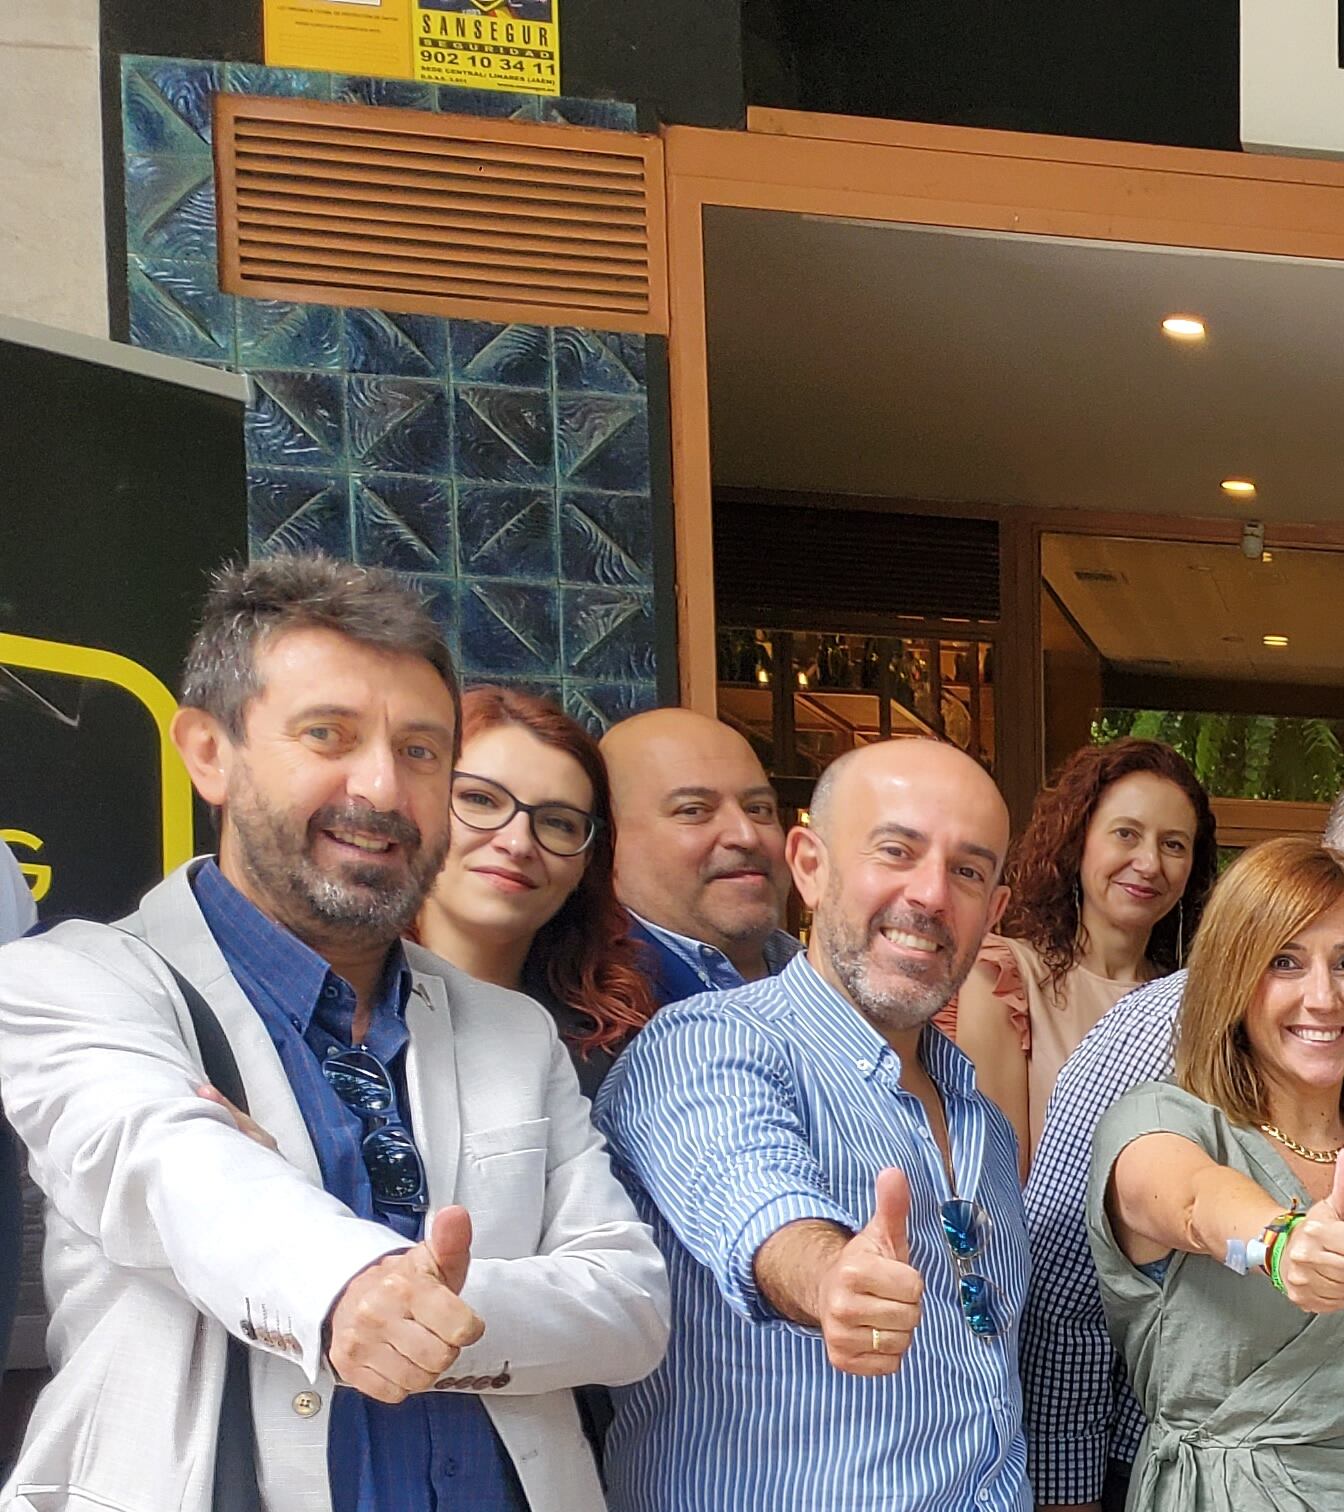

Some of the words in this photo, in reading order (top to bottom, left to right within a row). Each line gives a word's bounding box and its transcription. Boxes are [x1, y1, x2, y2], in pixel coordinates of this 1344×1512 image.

[422, 14, 549, 47] SANSEGUR
[423, 39, 550, 58] SEGURIDAD
[420, 50, 459, 65] 902
[467, 55, 491, 68] 10
[500, 59, 525, 72] 34
[533, 63, 555, 75] 11
